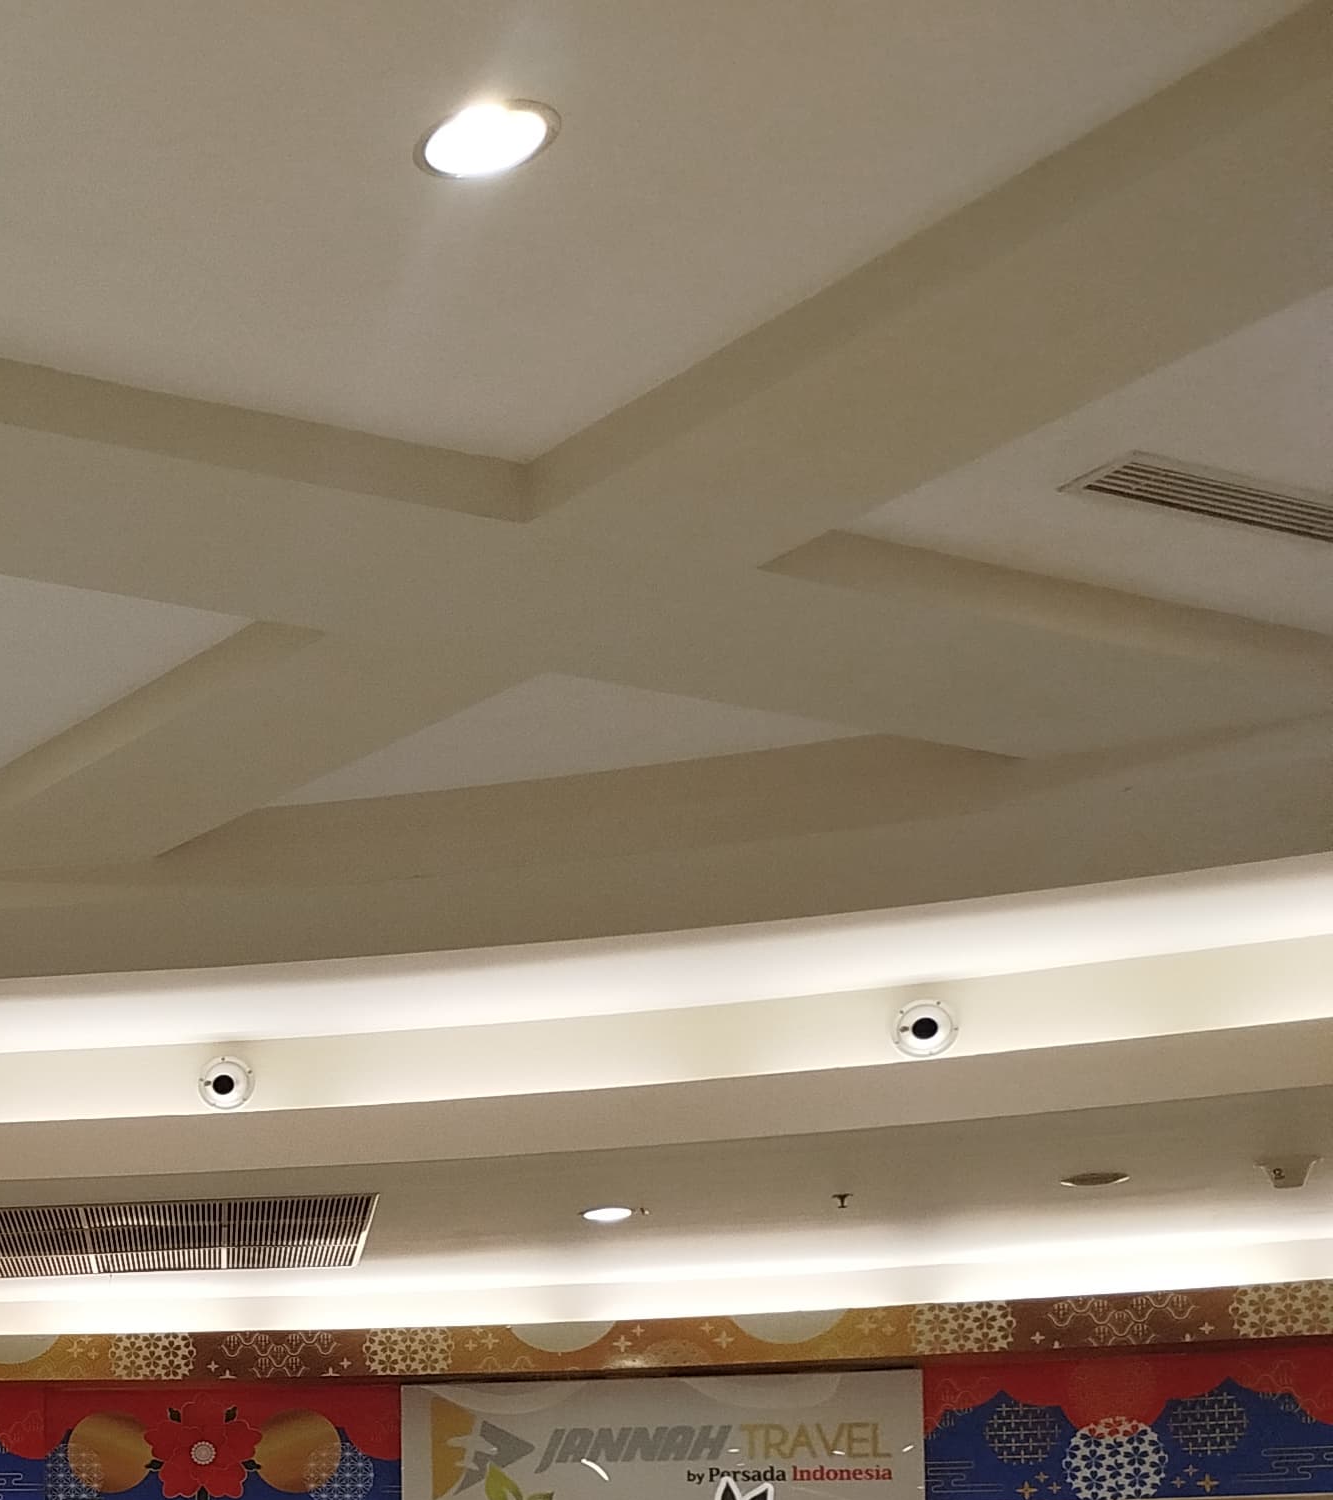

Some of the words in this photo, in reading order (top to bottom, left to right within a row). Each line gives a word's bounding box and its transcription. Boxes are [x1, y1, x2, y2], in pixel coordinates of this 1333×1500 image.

[535, 1425, 731, 1473] JANNAH
[739, 1422, 892, 1460] TRAVEL
[687, 1469, 705, 1486] by
[708, 1466, 786, 1483] Persada
[792, 1465, 892, 1482] Indonesia
